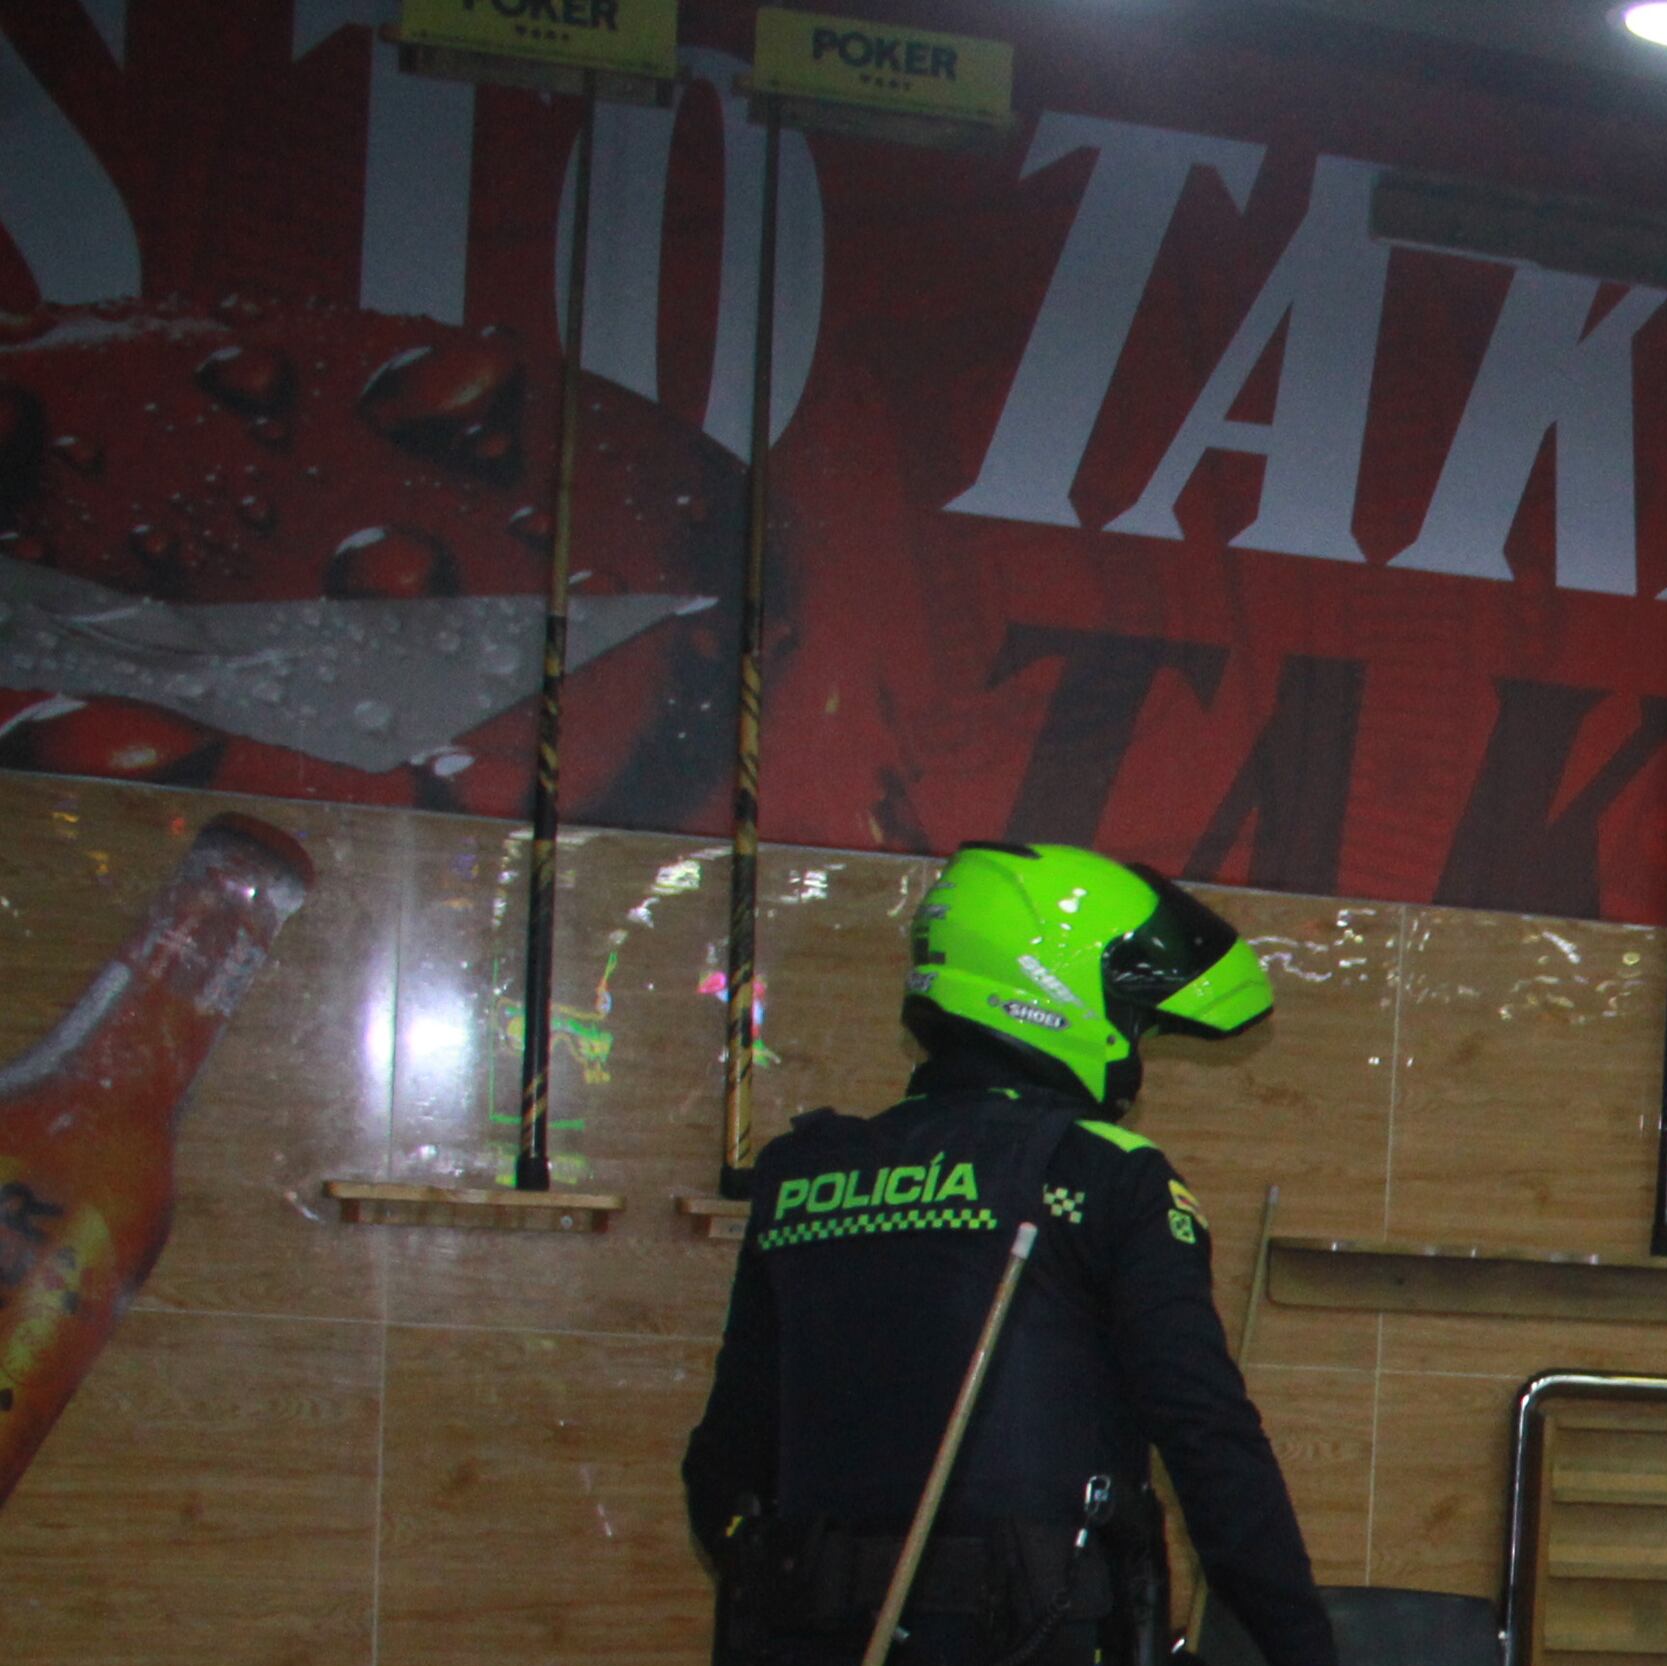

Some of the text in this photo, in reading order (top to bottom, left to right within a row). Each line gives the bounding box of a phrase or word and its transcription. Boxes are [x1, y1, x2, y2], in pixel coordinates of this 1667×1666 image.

[812, 27, 958, 82] POKER
[1008, 1002, 1062, 1028] SHOEI
[774, 1152, 979, 1220] POLICÍA
